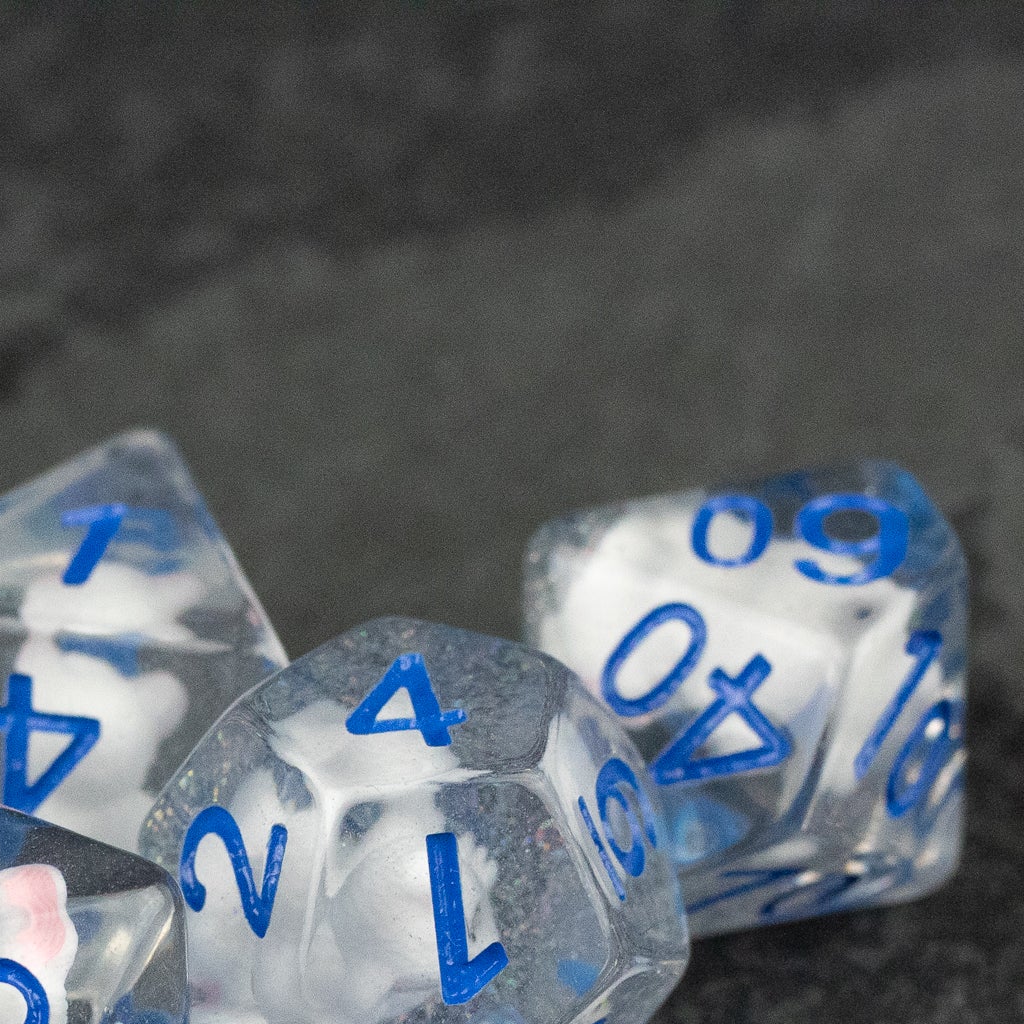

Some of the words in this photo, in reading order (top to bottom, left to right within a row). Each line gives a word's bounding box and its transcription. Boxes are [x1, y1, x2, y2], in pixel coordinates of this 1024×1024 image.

[346, 653, 467, 747] 4
[600, 601, 792, 785] 40
[180, 806, 288, 938] 2
[426, 832, 509, 1004] 1
